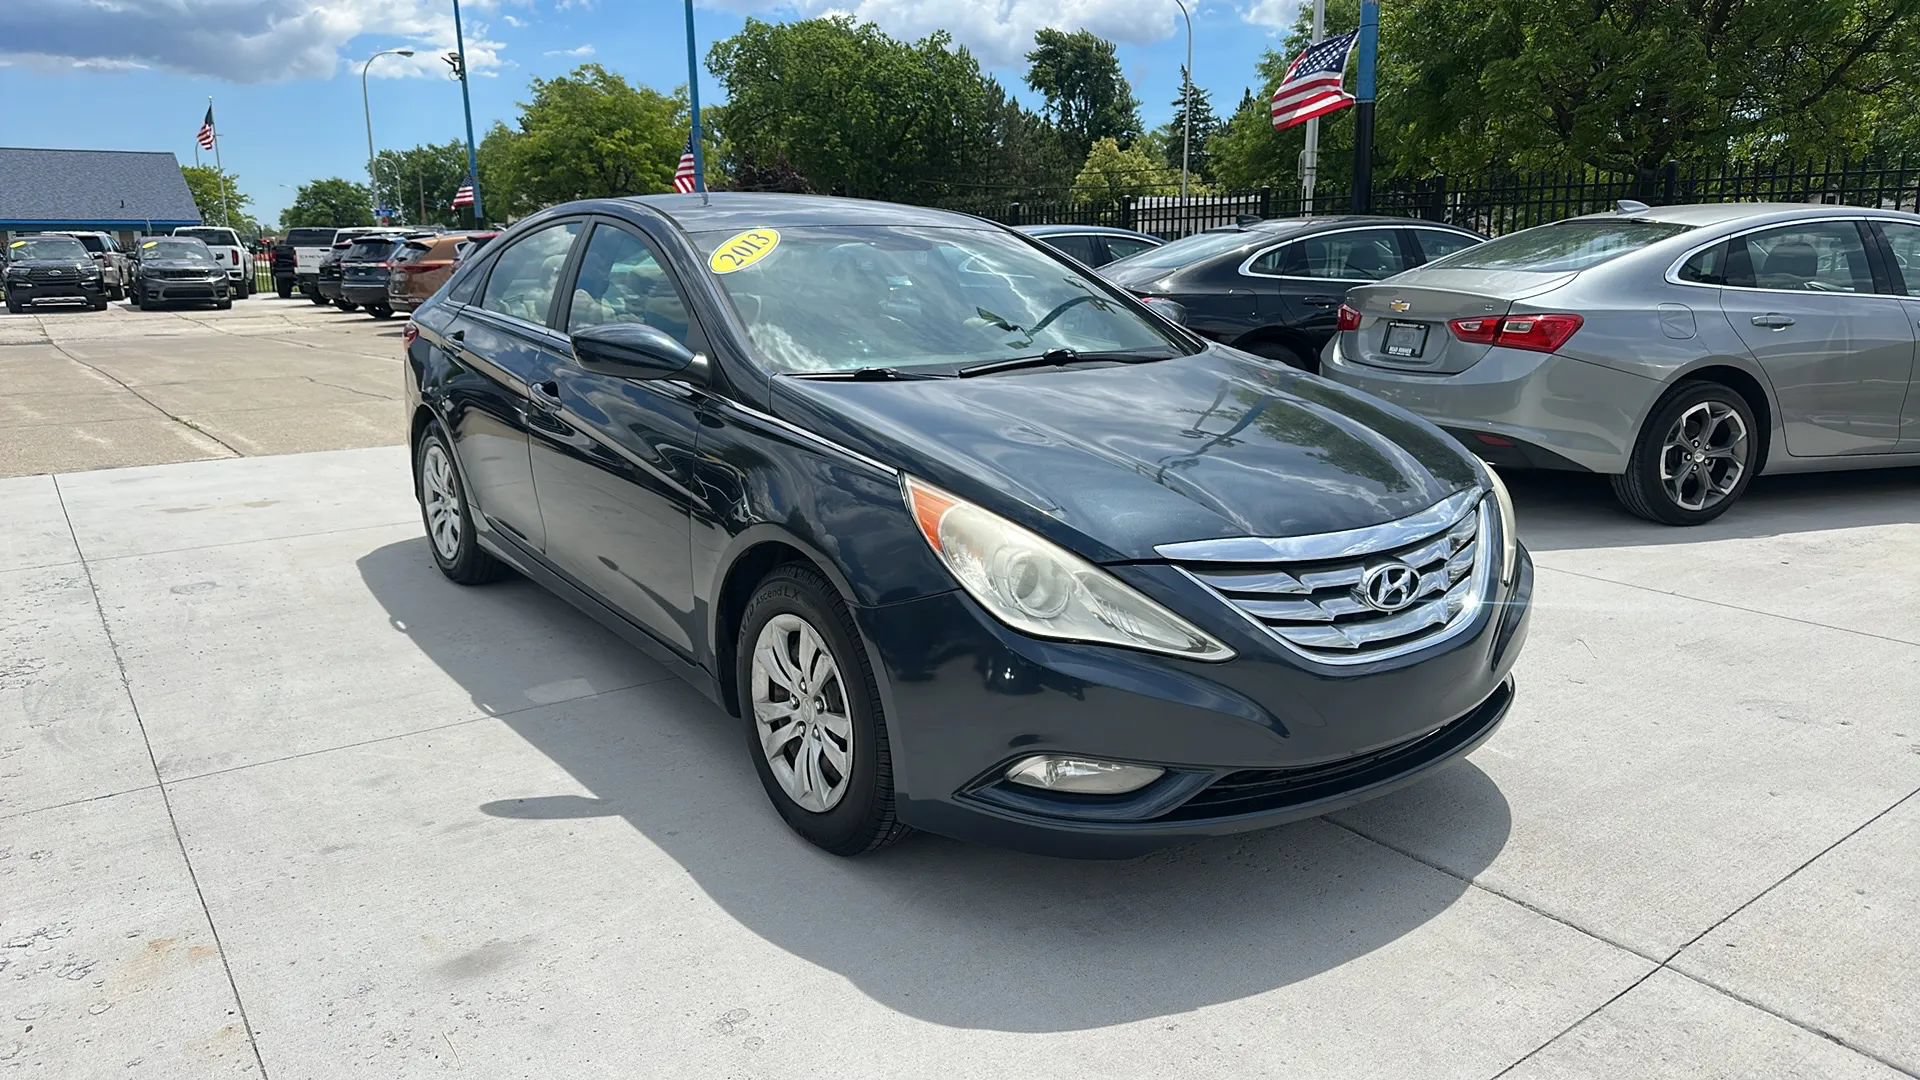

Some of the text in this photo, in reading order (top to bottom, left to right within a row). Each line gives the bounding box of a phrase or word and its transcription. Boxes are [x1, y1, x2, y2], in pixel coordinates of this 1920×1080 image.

[719, 234, 770, 266] 2013
[756, 588, 783, 606] Ascend
[784, 585, 801, 602] LX
